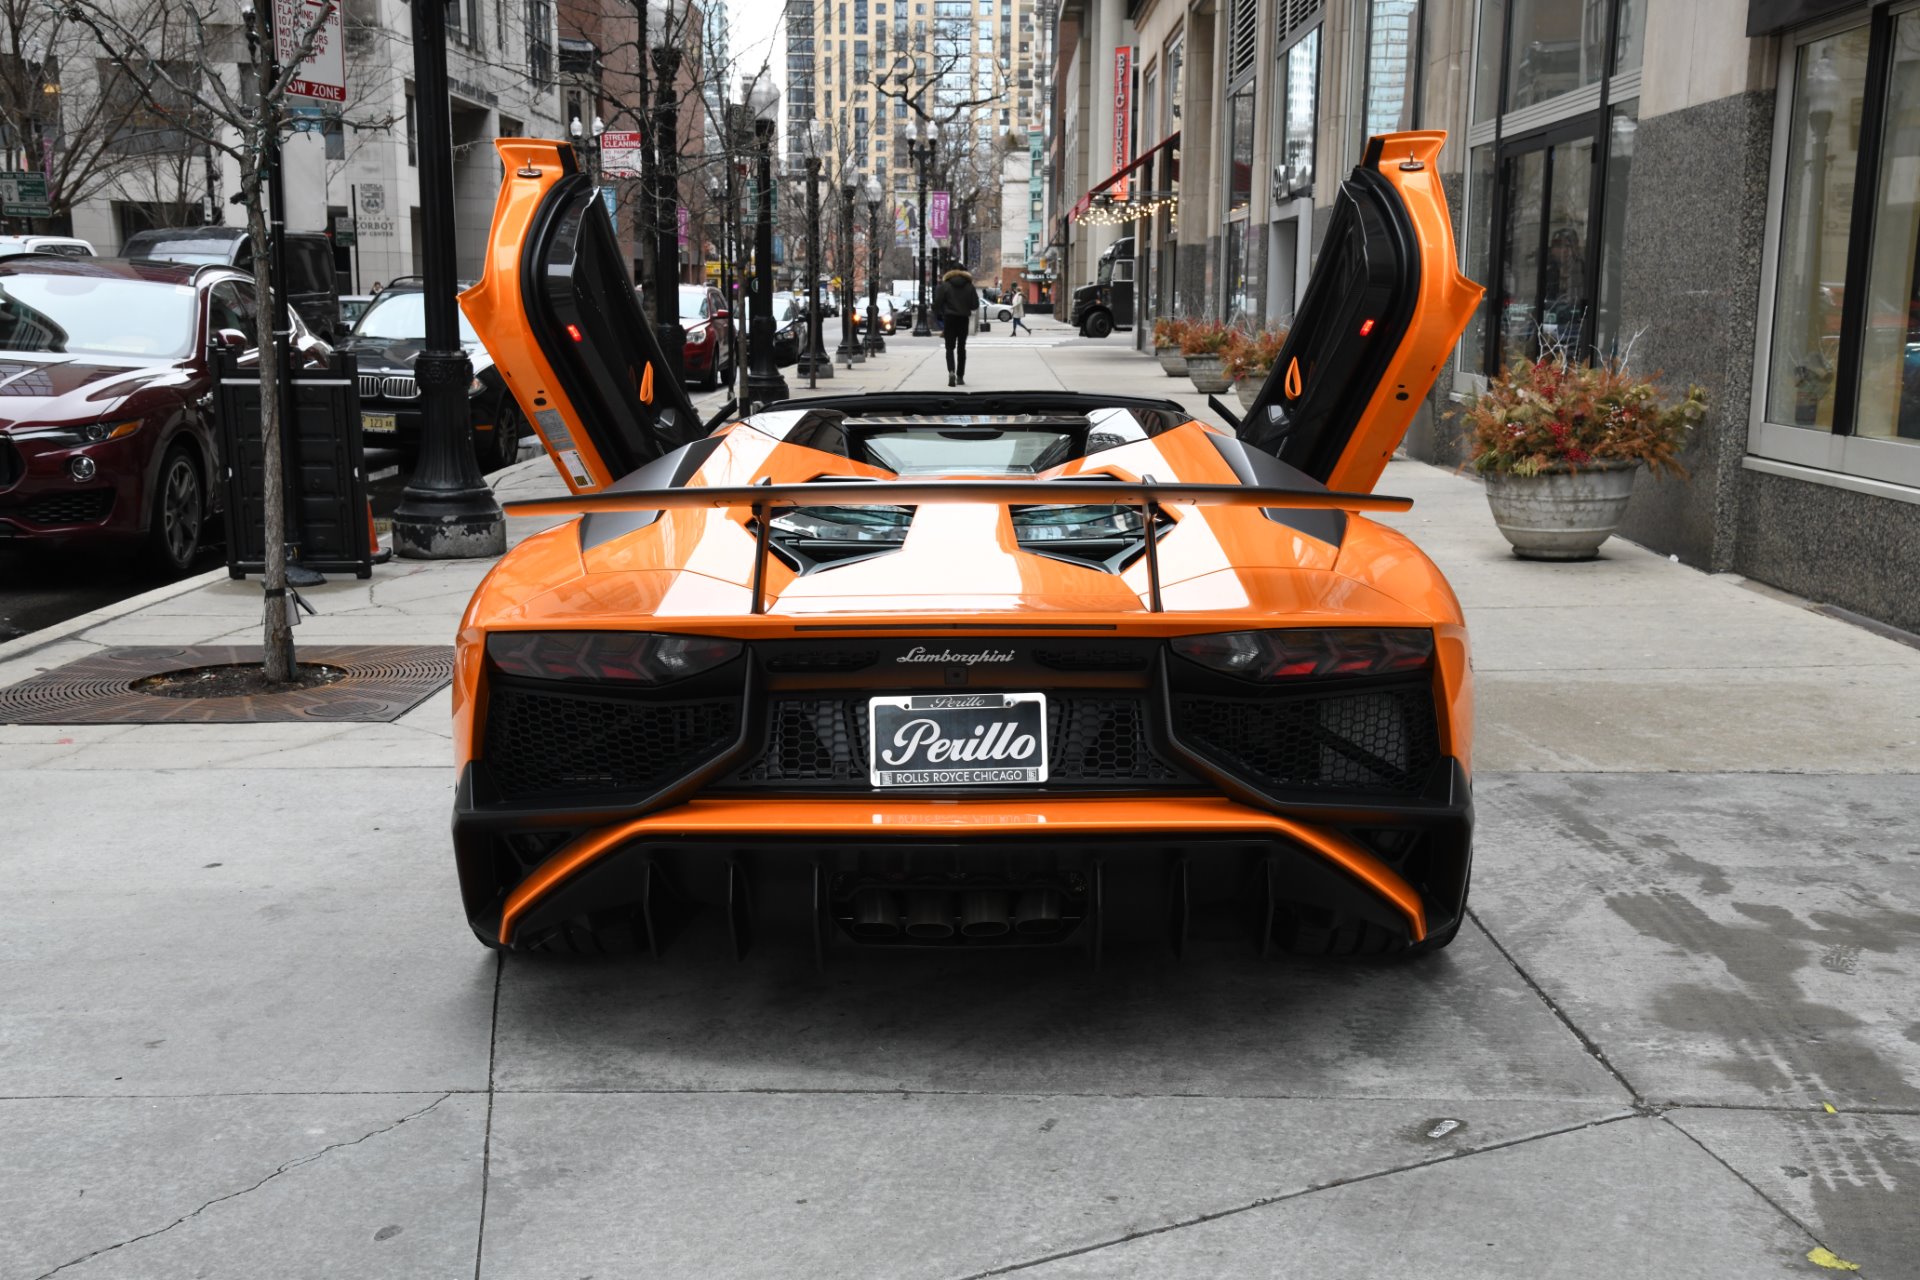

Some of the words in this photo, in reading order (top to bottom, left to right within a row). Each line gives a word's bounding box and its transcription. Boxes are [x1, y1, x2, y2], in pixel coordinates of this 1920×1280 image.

[288, 80, 306, 94] OW
[312, 83, 341, 100] ZONE
[1115, 53, 1126, 108] EPIC
[604, 140, 641, 148] CLEANING
[605, 133, 630, 141] STREET
[1115, 113, 1125, 193] BURGR
[896, 646, 1015, 666] Lamborghini
[929, 696, 985, 708] Perillo
[881, 718, 1036, 766] Perillo
[896, 772, 929, 784] ROLLS
[933, 771, 970, 783] ROYCE
[973, 770, 1022, 782] CHICAGO
